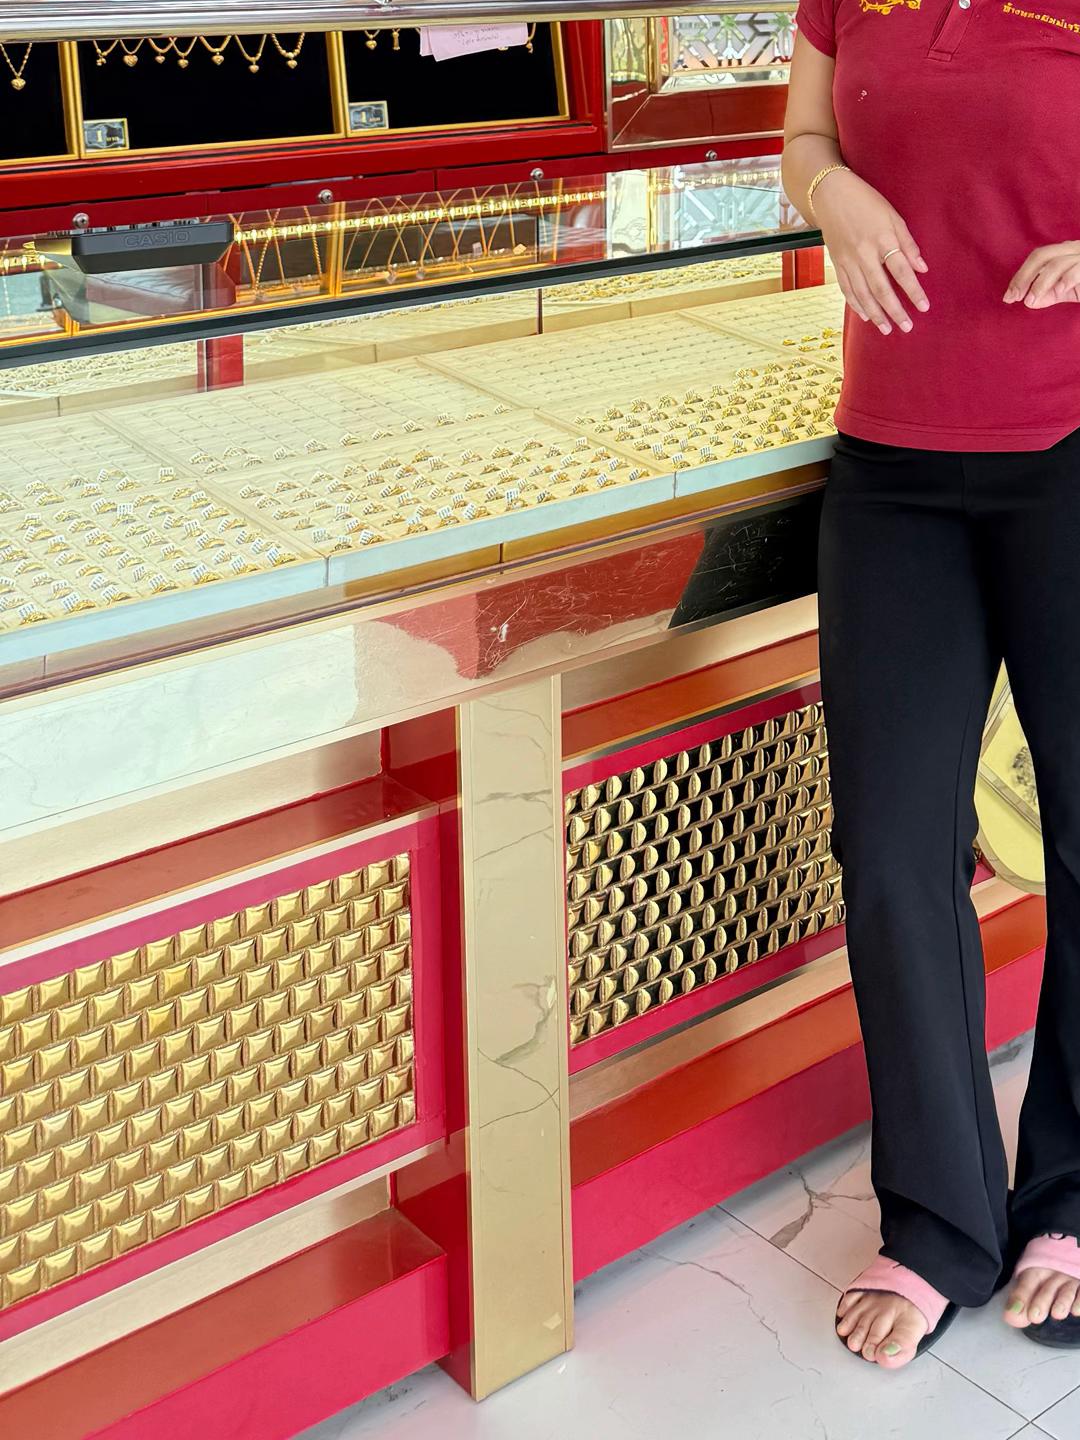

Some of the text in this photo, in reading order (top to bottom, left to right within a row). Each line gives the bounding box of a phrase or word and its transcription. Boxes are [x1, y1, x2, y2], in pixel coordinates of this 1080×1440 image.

[360, 111, 367, 123] 1
[96, 129, 103, 142] 1
[124, 231, 190, 248] CASIO
